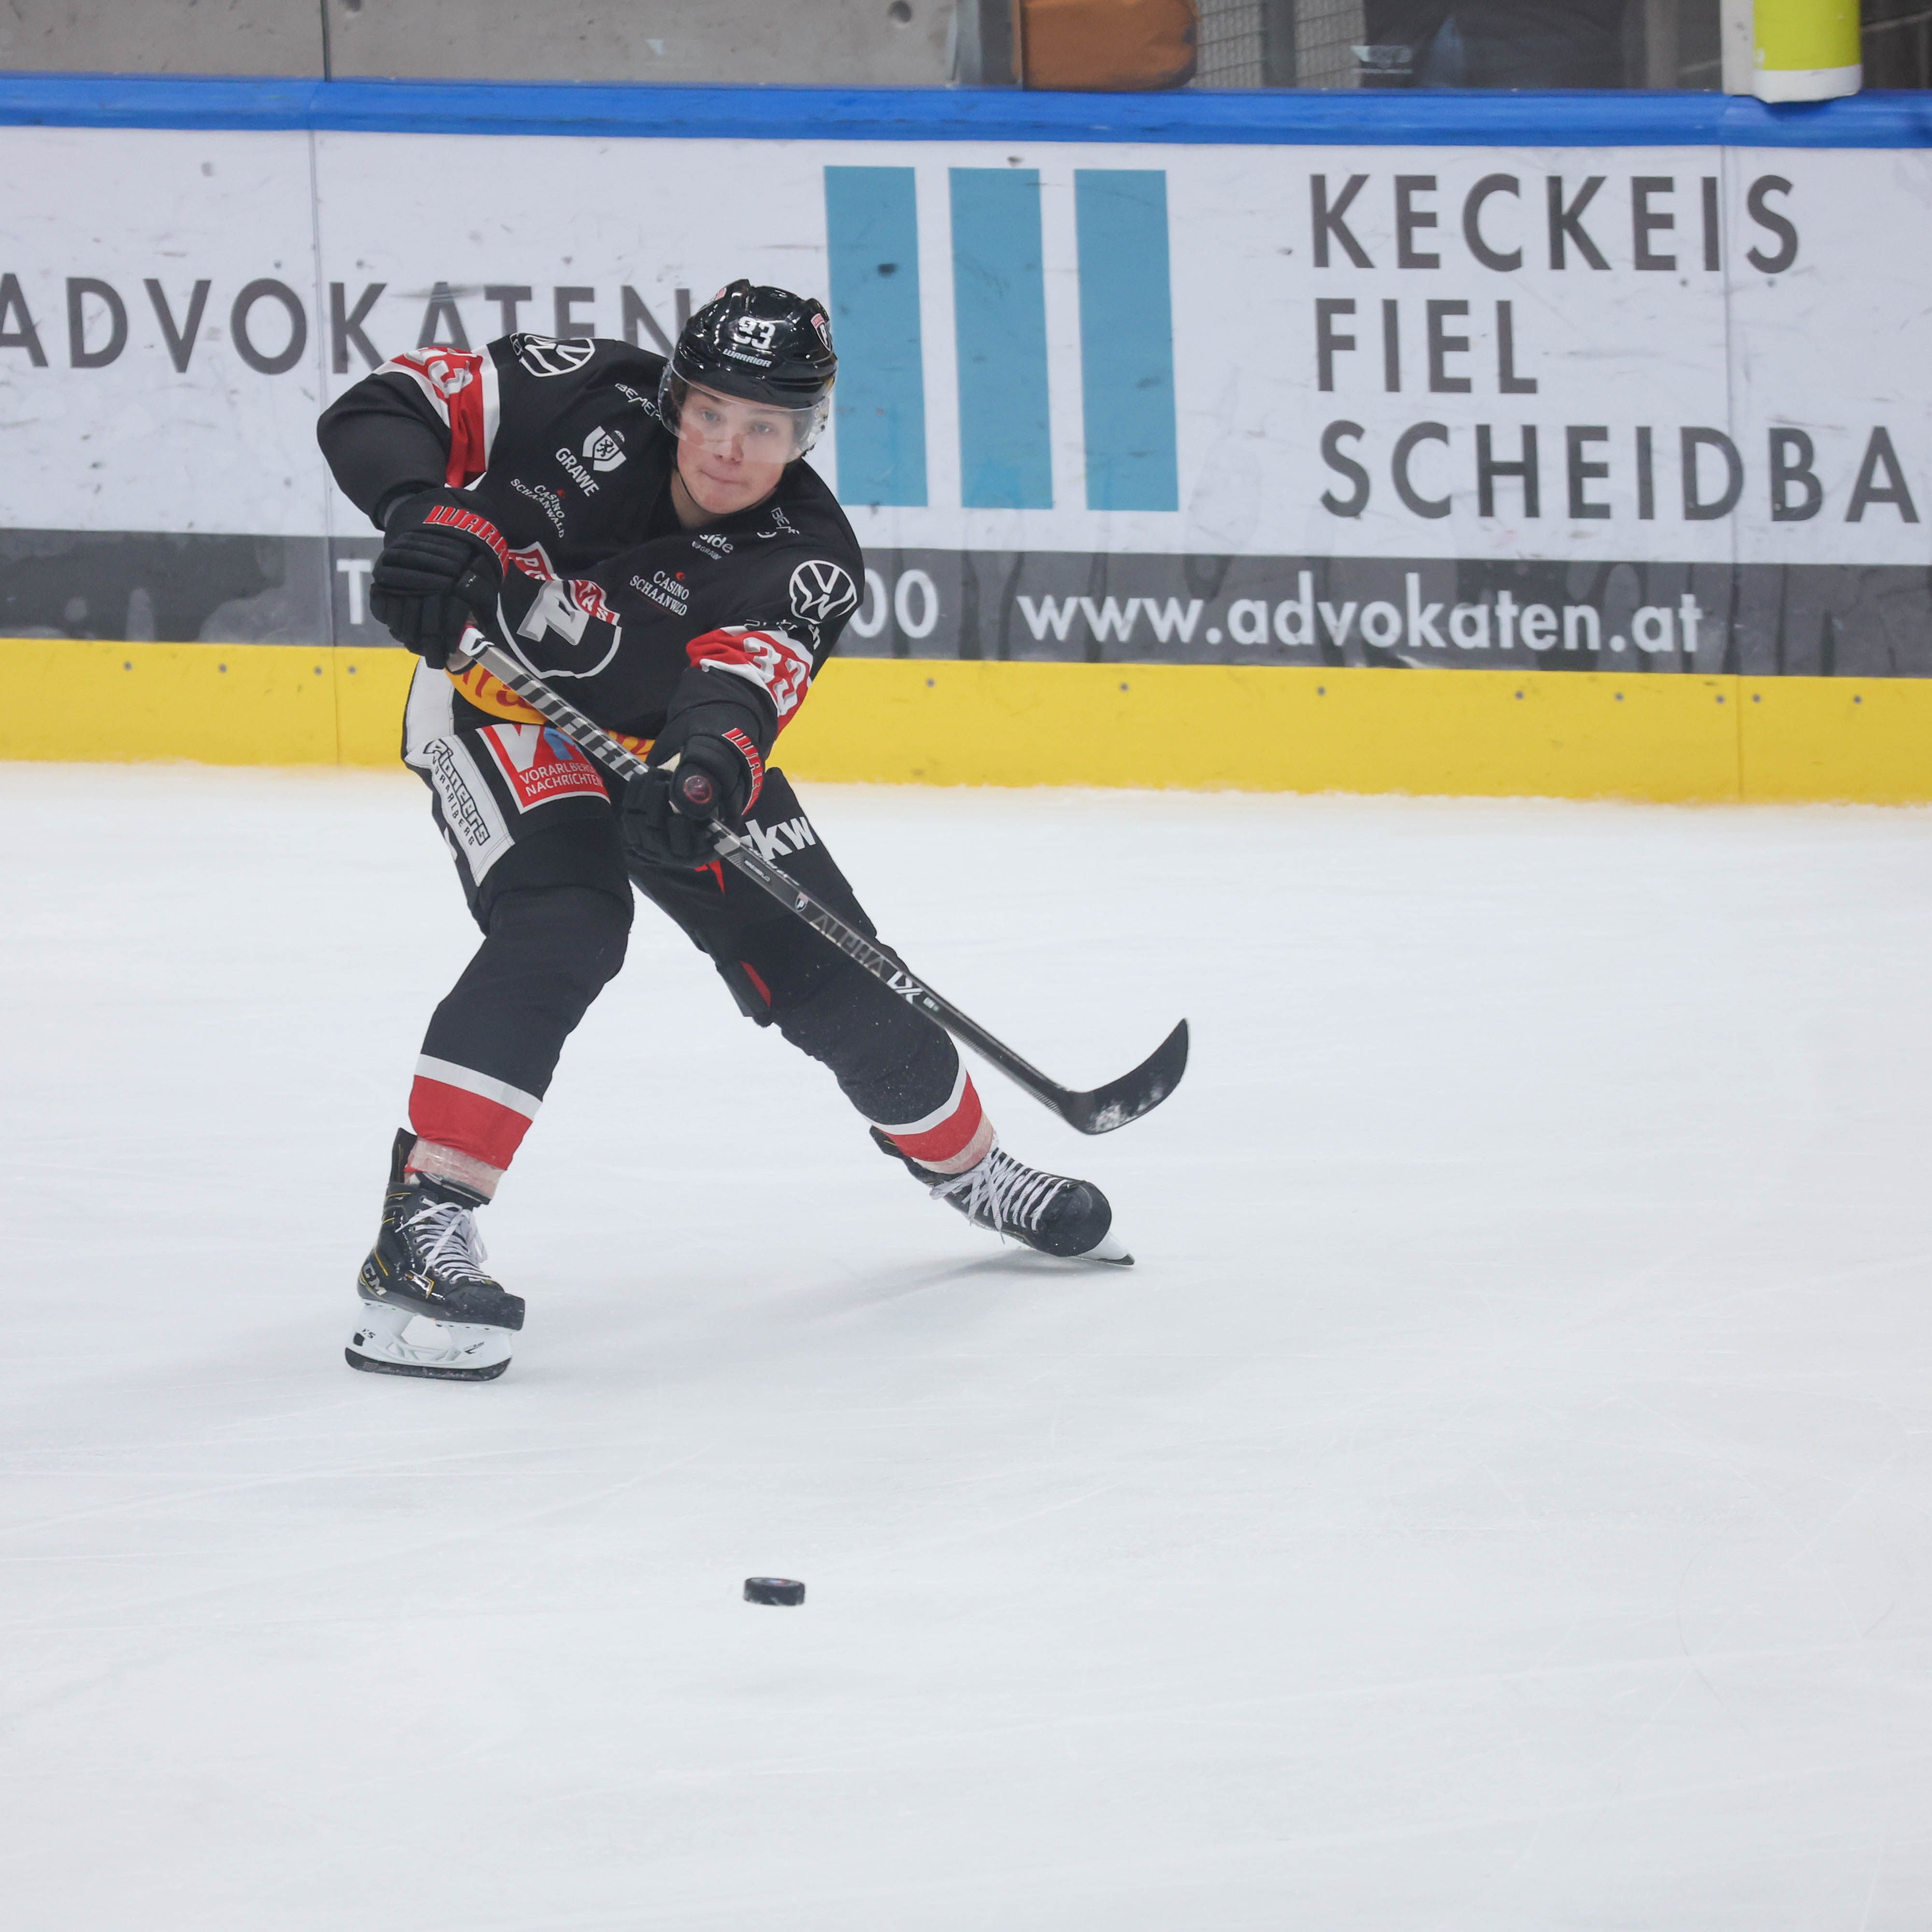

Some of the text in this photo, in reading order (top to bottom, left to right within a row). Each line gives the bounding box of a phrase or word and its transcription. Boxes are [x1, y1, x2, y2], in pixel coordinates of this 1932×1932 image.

[1310, 172, 1799, 274] KECKEIS
[0, 272, 691, 375] ADVOKATEN
[722, 348, 772, 368] WARRIOR
[1315, 298, 1539, 395] FIEL
[534, 484, 565, 519] CASINO
[555, 447, 599, 497] GRAWE
[1319, 419, 1920, 524] SCHEIDBA
[510, 478, 565, 539] SCHAANWALD
[653, 570, 690, 600] CASINO
[1017, 570, 1703, 653] www.advokaten.at
